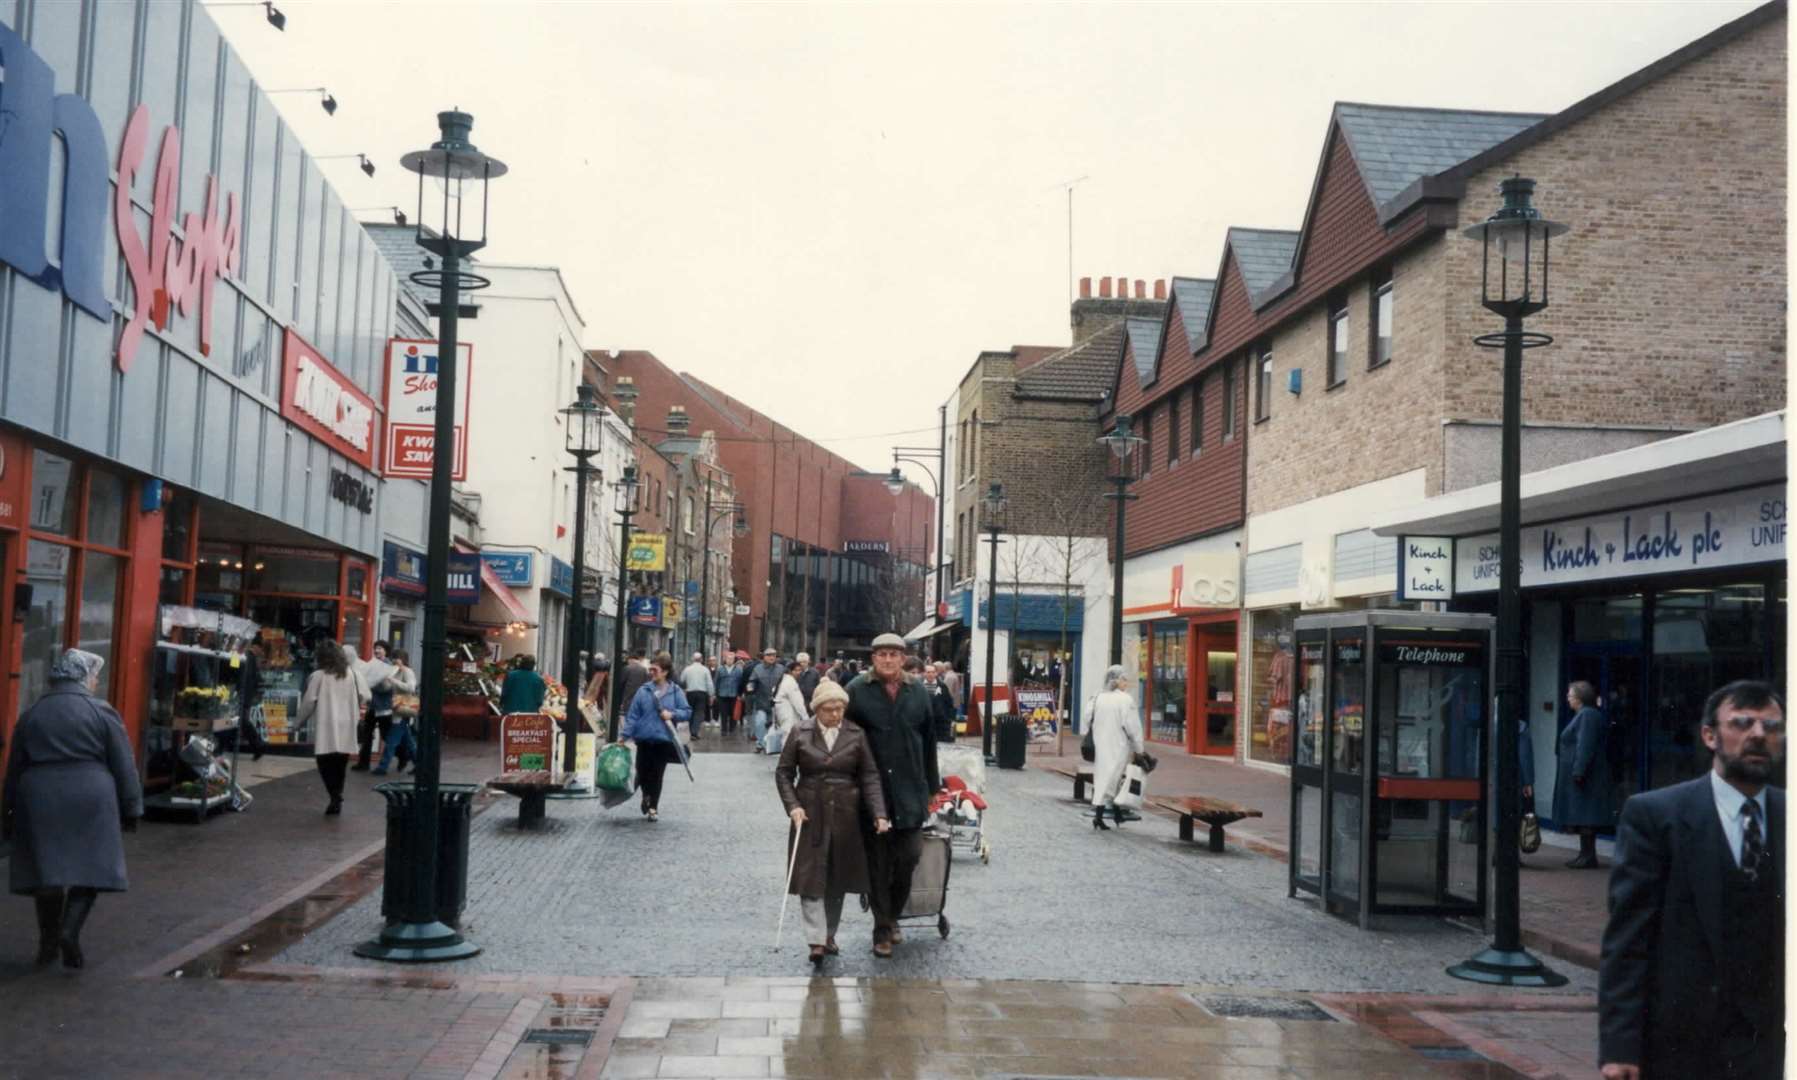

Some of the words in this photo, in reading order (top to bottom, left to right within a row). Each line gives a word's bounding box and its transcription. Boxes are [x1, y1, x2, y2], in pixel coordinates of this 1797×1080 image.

[115, 103, 240, 373] Shops
[403, 375, 438, 395] Sho
[402, 435, 435, 447] KWI
[402, 450, 434, 463] SAV
[1543, 527, 1600, 571] Kinch
[1623, 511, 1682, 563] Lack
[1692, 511, 1722, 565] plc
[1410, 543, 1448, 559] Kinch
[1479, 546, 1500, 562] SCH
[1472, 559, 1524, 580] UNIFOS
[447, 573, 475, 589] ILL
[1412, 577, 1446, 592] Lack
[1192, 577, 1238, 605] QS
[1397, 646, 1465, 664] Telephone
